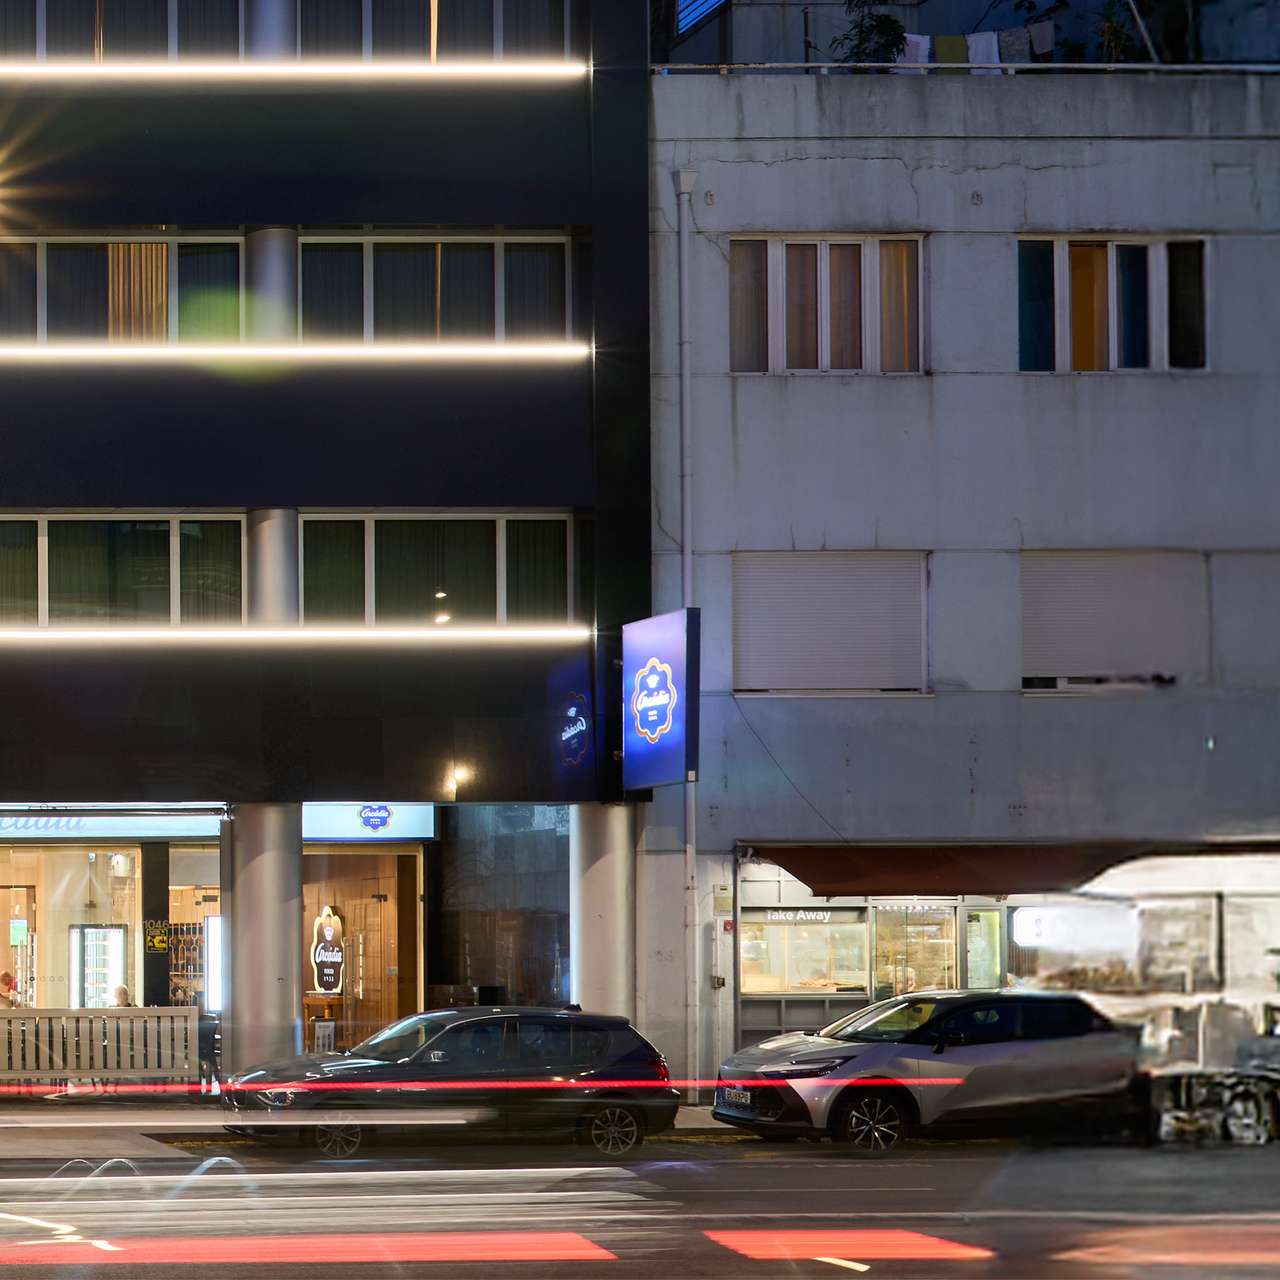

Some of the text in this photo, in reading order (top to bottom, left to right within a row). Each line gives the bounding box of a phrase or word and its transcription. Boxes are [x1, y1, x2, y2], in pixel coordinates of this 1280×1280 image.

[766, 909, 831, 923] Take Away
[143, 919, 169, 929] 1046
